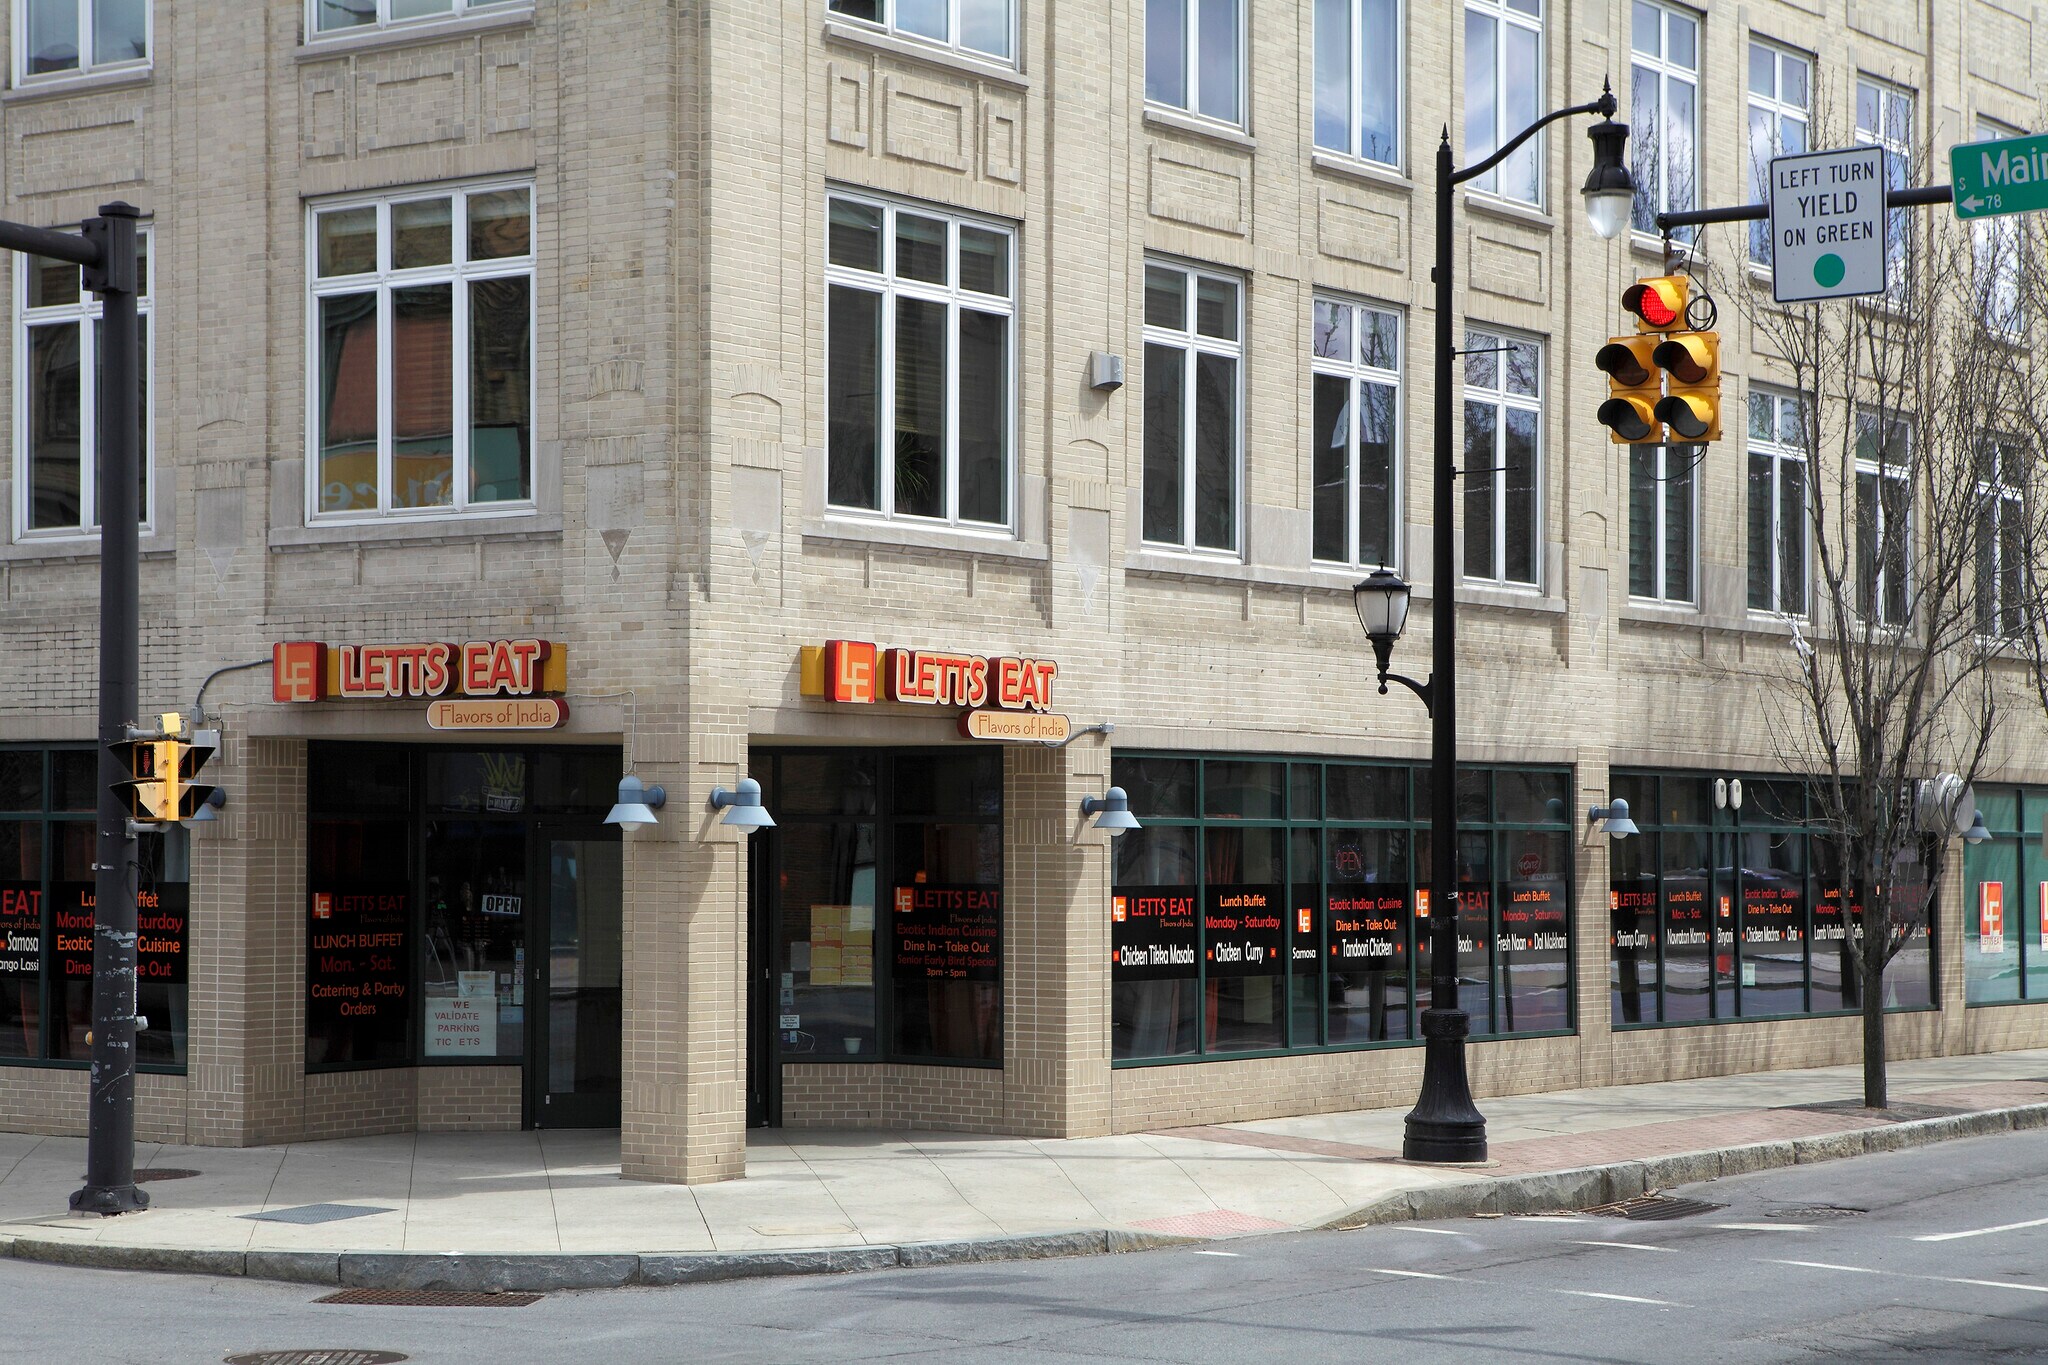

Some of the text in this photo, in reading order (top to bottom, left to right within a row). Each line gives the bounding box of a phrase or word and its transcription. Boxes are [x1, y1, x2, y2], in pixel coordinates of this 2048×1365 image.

[1780, 161, 1874, 189] LEFT TURN
[1959, 177, 1966, 191] S
[1797, 191, 1858, 218] YIELD
[1985, 195, 2002, 209] 78
[1784, 220, 1873, 247] ON GREEN
[280, 643, 536, 700] LE LETTS EAT
[841, 641, 1054, 705] LE LETTS EAT
[440, 704, 551, 727] Flavors of India
[978, 715, 1064, 738] Flavors of India
[137, 891, 159, 908] ffet
[914, 890, 962, 908] LETTS
[967, 891, 999, 909] EAT
[1220, 894, 1266, 907] Lunch Buffet
[1513, 890, 1550, 902] Lunch Buffet
[1620, 892, 1641, 907] LETTS
[1641, 892, 1656, 906] EAT
[1669, 891, 1702, 902] Lunch Buffet
[1745, 889, 1761, 899] Exotic
[1761, 889, 1778, 899] Indian
[1824, 889, 1839, 898] Lunch
[3, 890, 41, 915] EAT
[335, 896, 374, 912] LETTS
[379, 895, 405, 911] EAT
[485, 896, 520, 913] OPEN
[1113, 897, 1193, 922] LE LETTS EAT
[1329, 898, 1402, 910] Exotic Indian Cuisine
[1416, 890, 1428, 917] LE
[1467, 892, 1489, 910] EAT
[1747, 904, 1793, 914] Dine In Take Out
[1816, 904, 1836, 915] Monday
[1205, 915, 1237, 930] Monday
[1245, 915, 1280, 930] Saturday
[1299, 908, 1310, 932] LE
[1503, 910, 1529, 923] Monday
[1534, 908, 1563, 922] Saturday
[897, 923, 997, 938] Exotic Indian Cuisine
[1336, 918, 1397, 931] Dine In Take Out
[1814, 924, 1827, 940] Lamb
[7, 930, 39, 952] Samosa
[314, 933, 403, 949] LUNCH BUFFET
[1497, 934, 1510, 951] Fresh
[1511, 933, 1527, 951] Naan
[1534, 932, 1544, 950] Dal
[1617, 929, 1648, 949] Shrimp Curry
[1717, 927, 1733, 946] Biryani
[1746, 925, 1798, 943] Chicken Madras Chai
[57, 934, 181, 953] Exotic Cuisine
[903, 941, 925, 951] Dine
[927, 941, 936, 951] In
[944, 941, 969, 953] Take
[971, 942, 990, 953] Out
[1342, 937, 1392, 957] Tandoori Chicken
[1120, 944, 1194, 966] Chicken Tikka Masala
[1215, 941, 1263, 964] Chicken Curry
[1292, 947, 1316, 959] Samosa
[0, 960, 39, 972] ango Lassi
[66, 960, 91, 975] Dine
[150, 961, 172, 976] Out
[321, 956, 355, 972] Mon.
[370, 955, 396, 971] Sat.
[897, 955, 997, 968] Senior Early Bird Special
[926, 968, 943, 977] 3pm
[950, 968, 967, 978] 5pm
[312, 982, 404, 998] Catering & Party
[341, 1002, 376, 1016] Orders
[453, 1001, 470, 1009] WE
